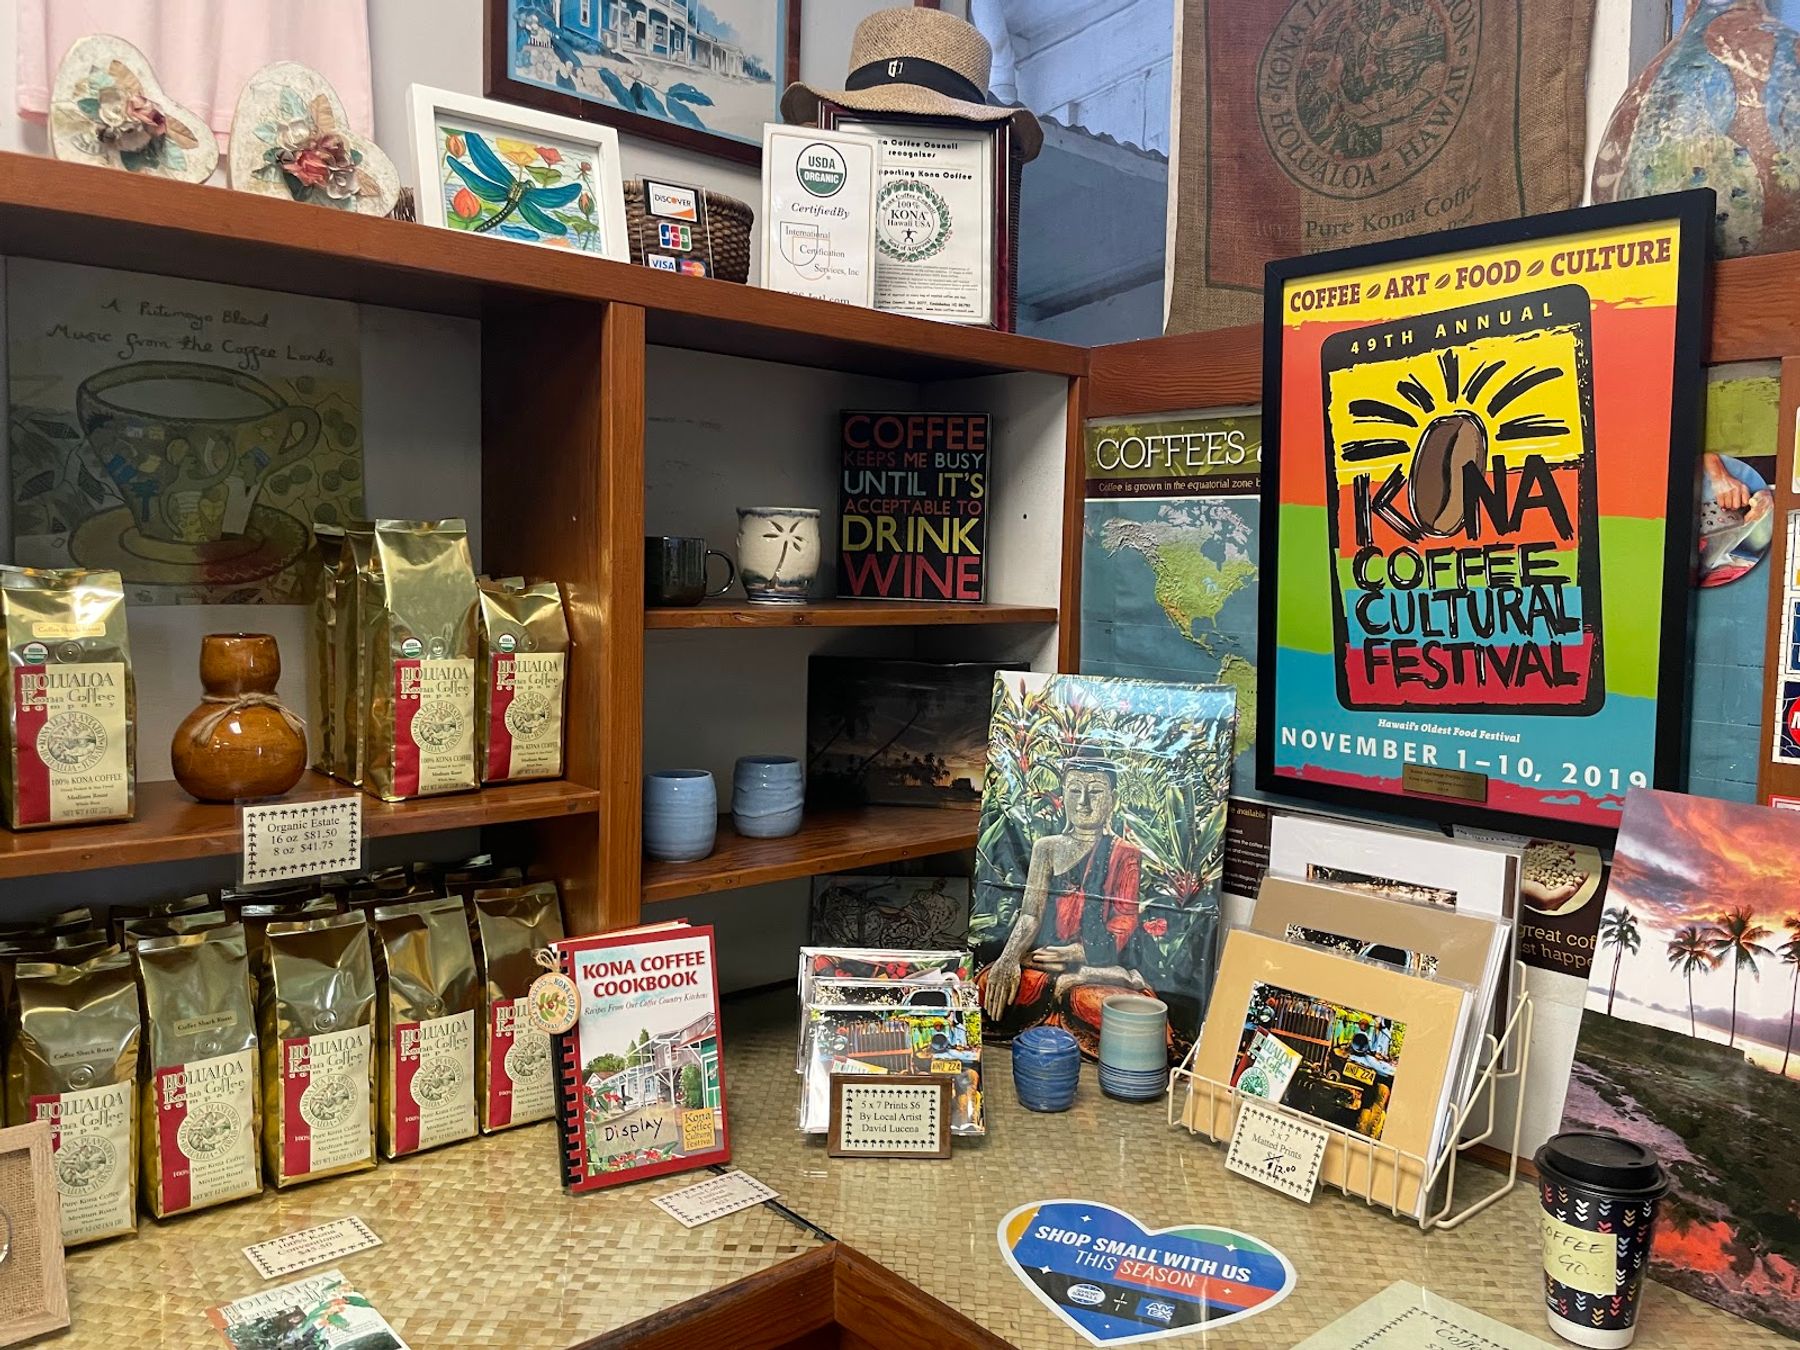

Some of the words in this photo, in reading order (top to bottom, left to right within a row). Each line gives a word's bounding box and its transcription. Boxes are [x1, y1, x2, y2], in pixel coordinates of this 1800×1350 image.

[891, 139, 921, 148] Coffee
[808, 155, 836, 170] USDA
[804, 172, 840, 185] ORGANIC
[918, 170, 940, 178] Kona
[943, 172, 973, 180] Coffee
[654, 194, 692, 207] DISCOVER
[891, 209, 926, 221] KONA
[914, 220, 931, 228] USA
[1306, 219, 1354, 238] Pure
[1361, 207, 1417, 234] Kona
[662, 229, 689, 243] JCB
[785, 225, 831, 240] International
[799, 244, 846, 259] Certification
[652, 259, 675, 270] VISA
[1290, 283, 1361, 314] COFFEE
[1384, 272, 1431, 301] ART
[1455, 260, 1522, 290] FOOD
[1551, 237, 1673, 278] CULTURE
[102, 299, 121, 313] A
[1350, 330, 1414, 355] 49TH
[1435, 302, 1554, 339] ANNUAL
[48, 323, 112, 343] Music
[118, 333, 168, 360] from
[177, 336, 214, 354] the
[844, 415, 986, 450] COFFEE
[1096, 430, 1246, 471] COFFEES
[843, 451, 896, 468] KEEPS
[903, 452, 928, 468] ME
[934, 452, 984, 469] BUSY
[843, 470, 927, 497] UNTIL
[938, 472, 985, 499] IT'S
[1099, 481, 1123, 493] Coffee
[1125, 483, 1132, 492] is
[1133, 482, 1162, 494] grown
[1164, 480, 1172, 490] in
[1173, 480, 1186, 490] the
[1187, 478, 1230, 492] equatorial
[1231, 479, 1253, 489] zone
[843, 498, 951, 516] ACCEPTABLE
[957, 500, 982, 516] TO
[1353, 452, 1576, 549] KONA
[842, 514, 981, 555] DRINK
[842, 552, 981, 600] WINE
[1352, 541, 1572, 593] COFFEE
[1354, 582, 1582, 640] CULTURAL
[497, 660, 559, 673] HOLUALOA
[1363, 638, 1582, 690] FESTIVAL
[21, 671, 114, 691] HOLUALOA
[401, 666, 469, 682] HOLUALOA
[67, 687, 116, 703] Coffee
[1420, 722, 1452, 737] Oldest
[1453, 725, 1477, 740] Food
[1478, 728, 1521, 744] Festival
[1281, 726, 1439, 766] NOVEMBER
[1562, 761, 1648, 790] 2019
[71, 774, 94, 784] KONA
[94, 773, 123, 783] COFFEE
[267, 820, 308, 834] Organic
[311, 816, 340, 828] Estate
[271, 834, 284, 845] 16
[286, 835, 299, 843] oz
[304, 828, 338, 841] $81.50
[273, 847, 280, 856] 8
[282, 847, 295, 855] oz
[300, 840, 334, 853] $41.75
[1518, 922, 1562, 944] great
[582, 959, 636, 980] KONA
[640, 950, 706, 972] COFFEE
[593, 970, 698, 998] COOKBOOK
[400, 1019, 469, 1043] HOLUALOA
[289, 1035, 364, 1060] HOLUALOA
[162, 1060, 245, 1092] HOLUALOA
[36, 1092, 124, 1120] HOLUALOA
[861, 1101, 868, 1110] 5
[875, 1101, 882, 1110] 7
[883, 1100, 909, 1111] Prints
[910, 1100, 921, 1111] $6
[684, 1110, 712, 1125] Kona
[859, 1112, 872, 1123] By
[873, 1112, 897, 1123] Local
[898, 1112, 923, 1123] Artist
[605, 1116, 664, 1142] Display
[684, 1121, 712, 1134] Coffee
[861, 1124, 888, 1134] David
[889, 1124, 920, 1134] Lucena
[1269, 1128, 1277, 1138] 5
[1251, 1132, 1280, 1151] Matted
[1279, 1143, 1303, 1161] Prints
[1035, 1225, 1092, 1247] SHOP
[1092, 1237, 1163, 1264] SMALL
[1163, 1252, 1218, 1276] WITH
[1220, 1264, 1253, 1283] US
[1074, 1249, 1119, 1273] THIS
[1119, 1260, 1197, 1289] SEASON
